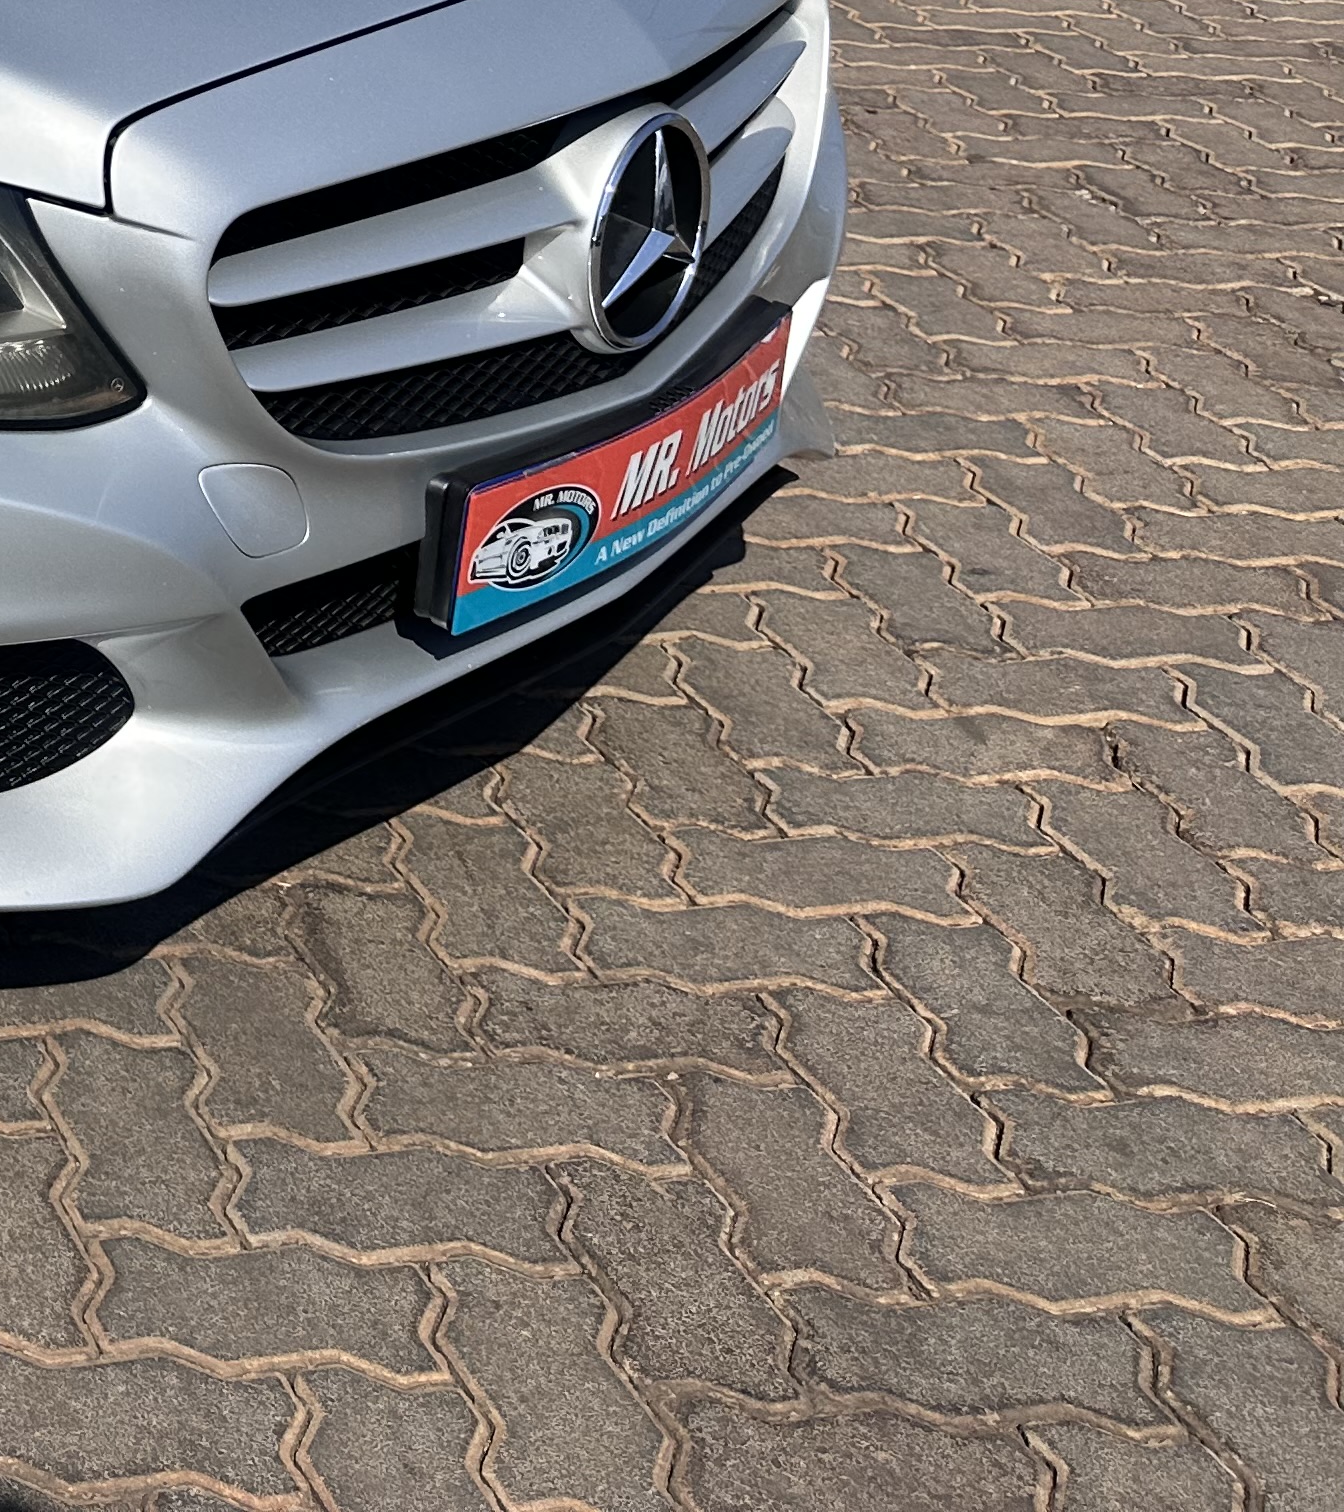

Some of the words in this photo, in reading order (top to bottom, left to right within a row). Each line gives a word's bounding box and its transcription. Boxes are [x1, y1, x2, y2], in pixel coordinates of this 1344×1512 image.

[609, 429, 683, 521] MR.
[685, 358, 781, 479] Motors
[532, 492, 556, 511] MR.
[556, 489, 597, 515] MOTORS
[594, 545, 608, 566] A
[610, 528, 645, 557] New
[646, 483, 709, 539] Definition
[710, 472, 724, 491] to
